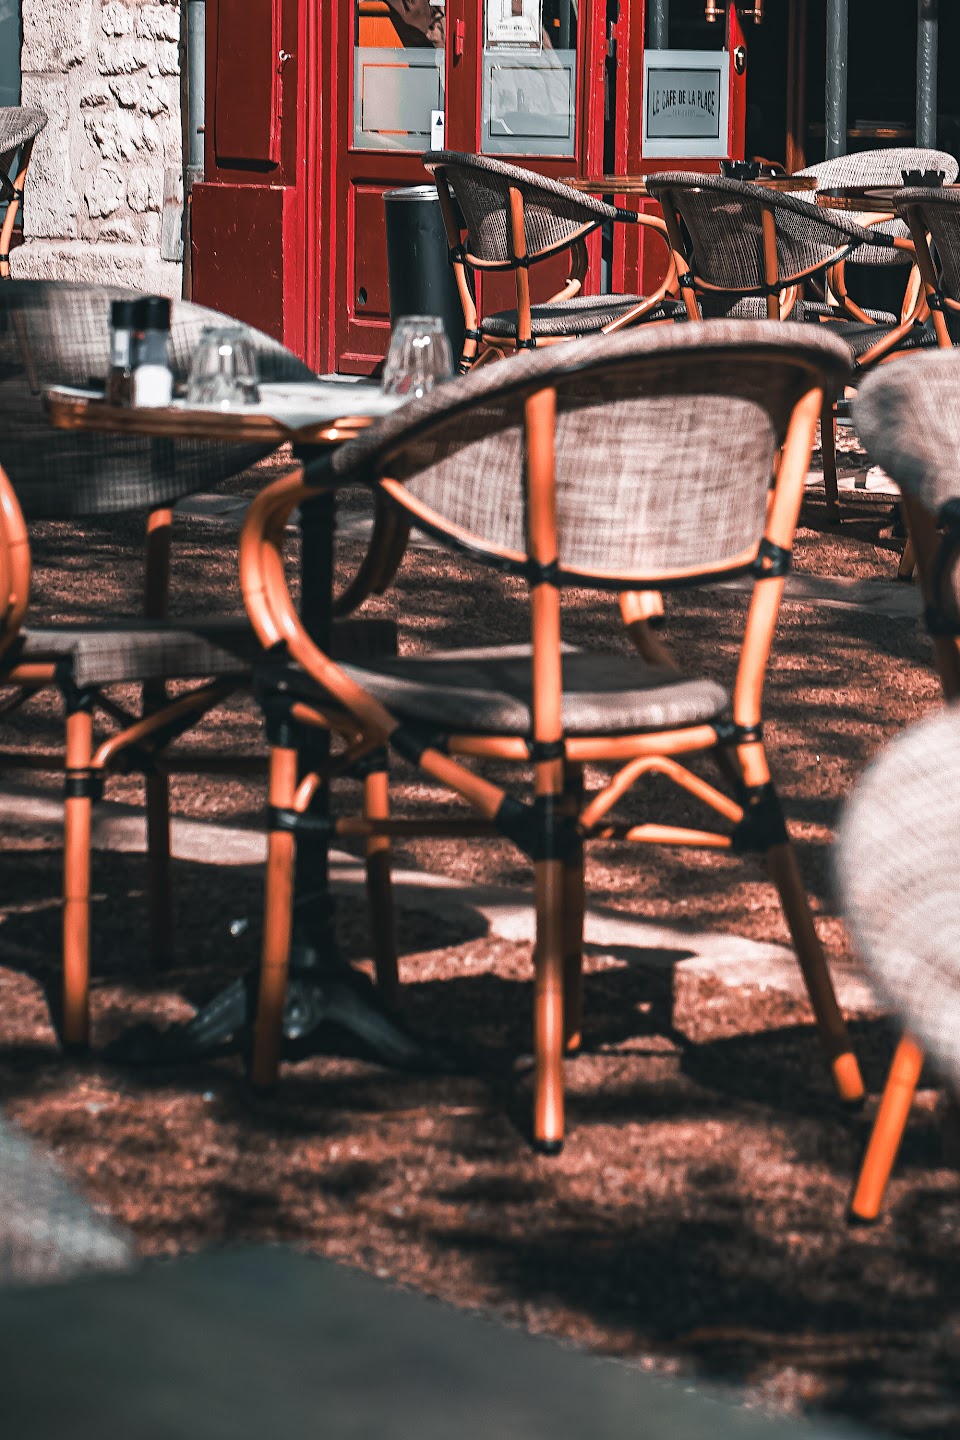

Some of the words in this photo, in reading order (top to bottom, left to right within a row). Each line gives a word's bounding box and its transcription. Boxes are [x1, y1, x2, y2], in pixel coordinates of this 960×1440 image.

[652, 90, 660, 117] LE
[662, 89, 677, 110] CAFE
[678, 89, 687, 105] DE
[688, 90, 696, 106] LA
[698, 89, 715, 117] PLACE
